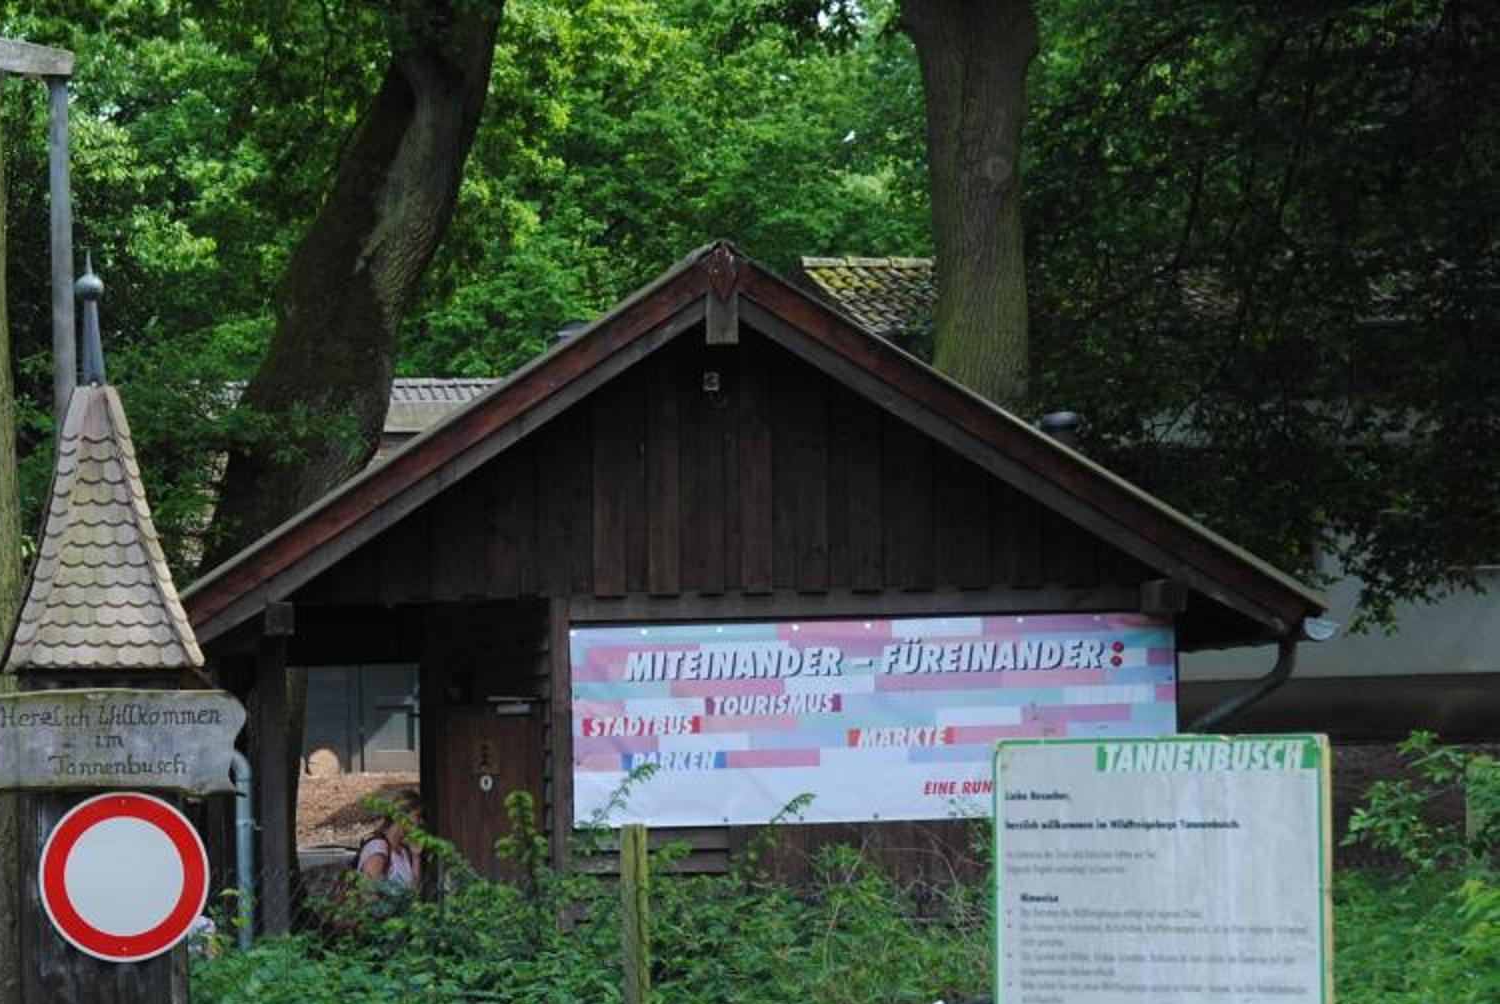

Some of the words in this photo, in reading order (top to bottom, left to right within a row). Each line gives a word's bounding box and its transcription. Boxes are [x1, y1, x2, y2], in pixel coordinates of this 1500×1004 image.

[626, 647, 842, 683] MITEINANDER
[713, 694, 834, 716] TOURISMUS
[98, 703, 222, 730] Willkommen
[590, 716, 693, 737] STADTBUS
[95, 735, 125, 749] im
[47, 752, 187, 776] Tannenbusch
[631, 751, 717, 769] PARKEN
[1106, 742, 1304, 772] TANNENBUSCH
[924, 781, 956, 795] EINE
